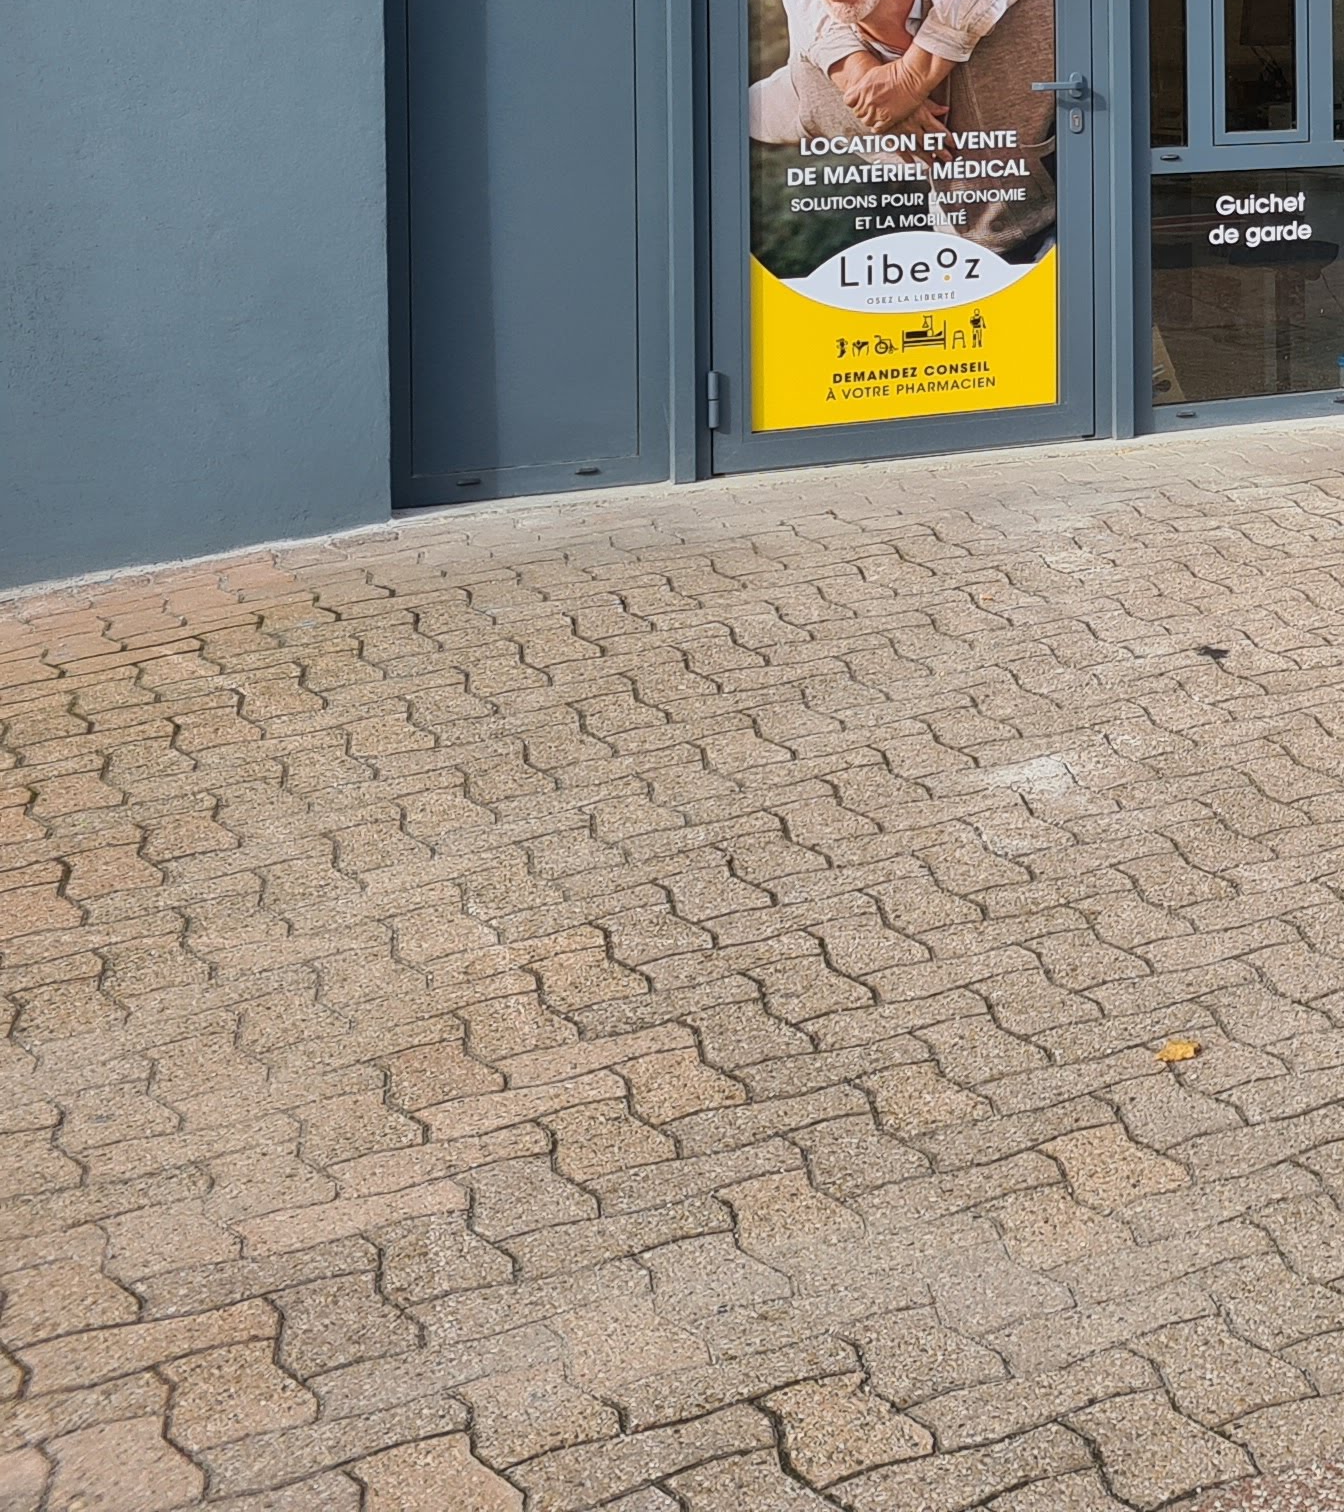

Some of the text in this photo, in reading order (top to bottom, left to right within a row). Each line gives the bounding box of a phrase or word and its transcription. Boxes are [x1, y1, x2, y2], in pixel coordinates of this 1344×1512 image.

[800, 130, 1017, 156] LOCATION ET VENTE
[787, 156, 1031, 186] DE MATÉRIEL MÉDICAL
[791, 195, 878, 212] SOLUTIONS
[881, 192, 924, 207] POUR
[1216, 192, 1306, 215] Guichet
[855, 211, 967, 230] ET LA MOBILITÉ
[1208, 220, 1312, 248] de garde
[866, 291, 955, 305] OSEZ LA LIBERTÉ
[832, 361, 990, 384] DEMANDEZ CONSEIL
[826, 376, 996, 401] À VOTRE PHARMACIEN
